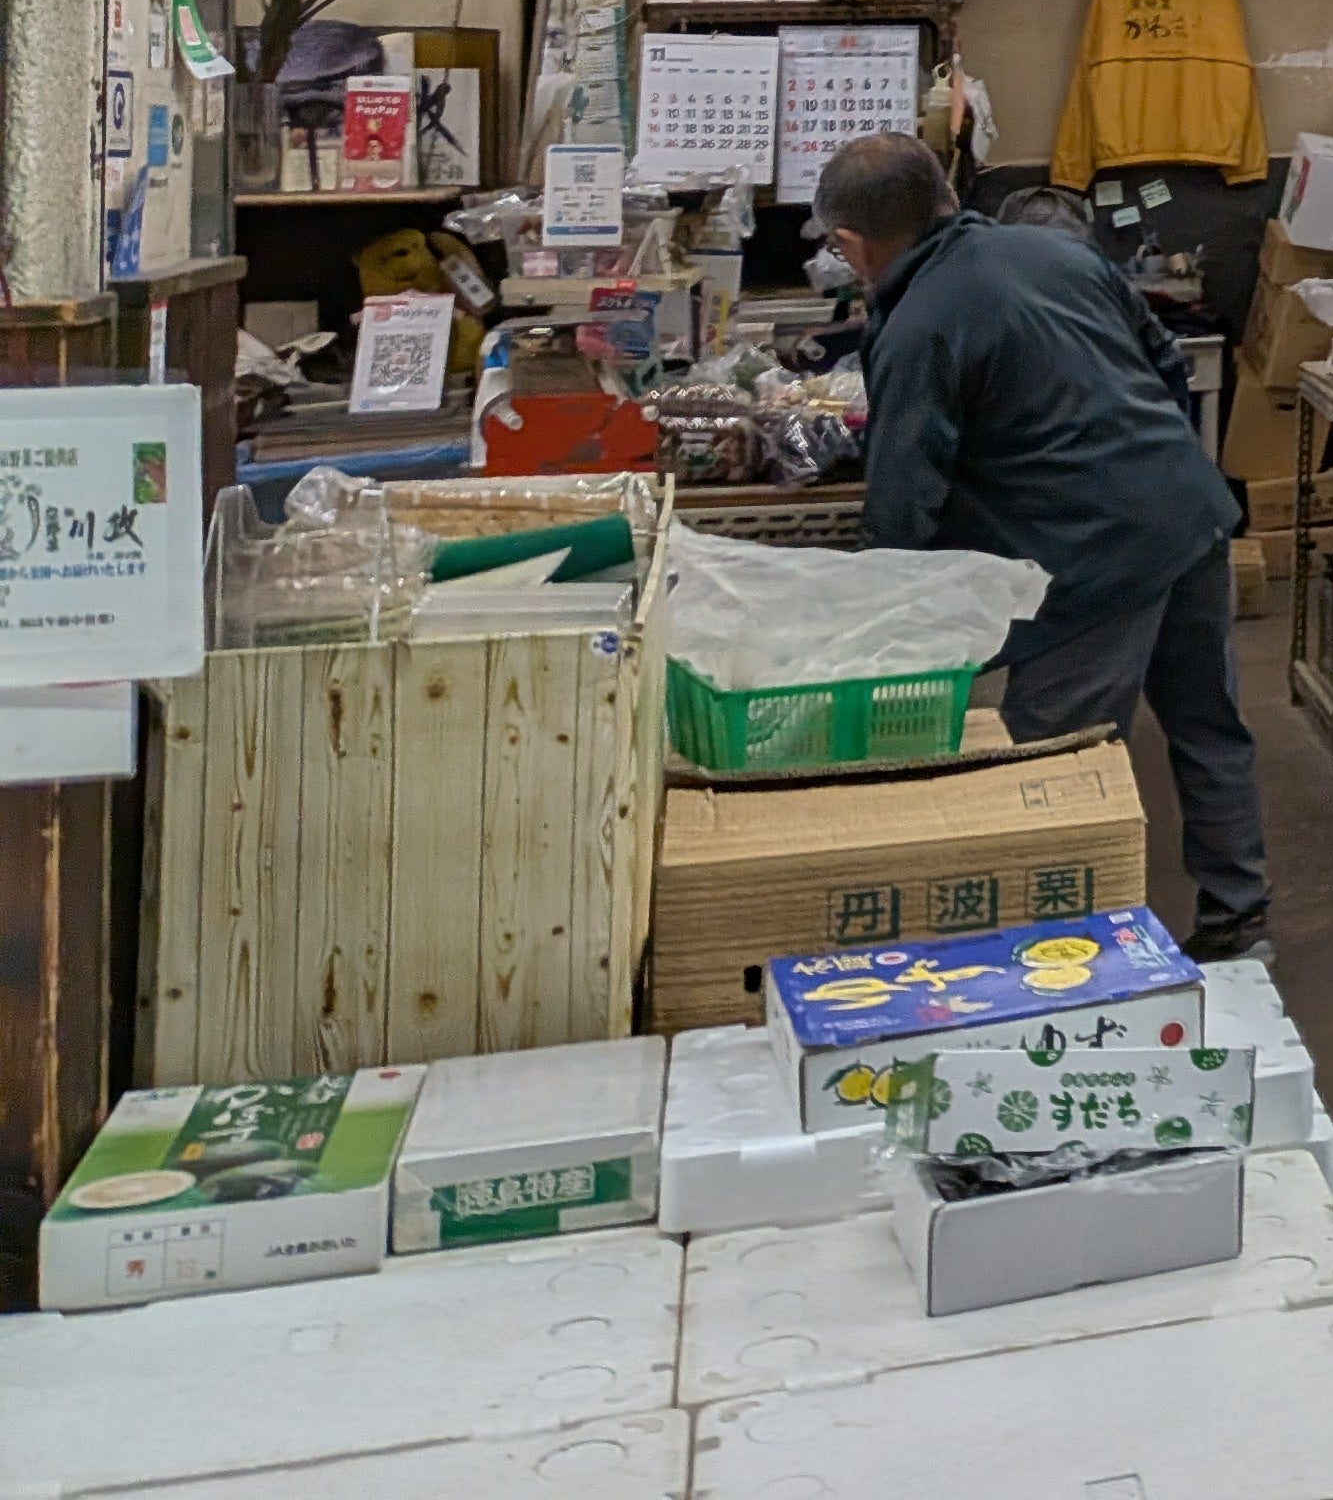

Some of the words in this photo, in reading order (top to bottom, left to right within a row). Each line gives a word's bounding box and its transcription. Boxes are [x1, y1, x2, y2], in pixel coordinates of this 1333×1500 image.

[836, 868, 1080, 934] 丹波栗
[1049, 1090, 1142, 1131] すだち
